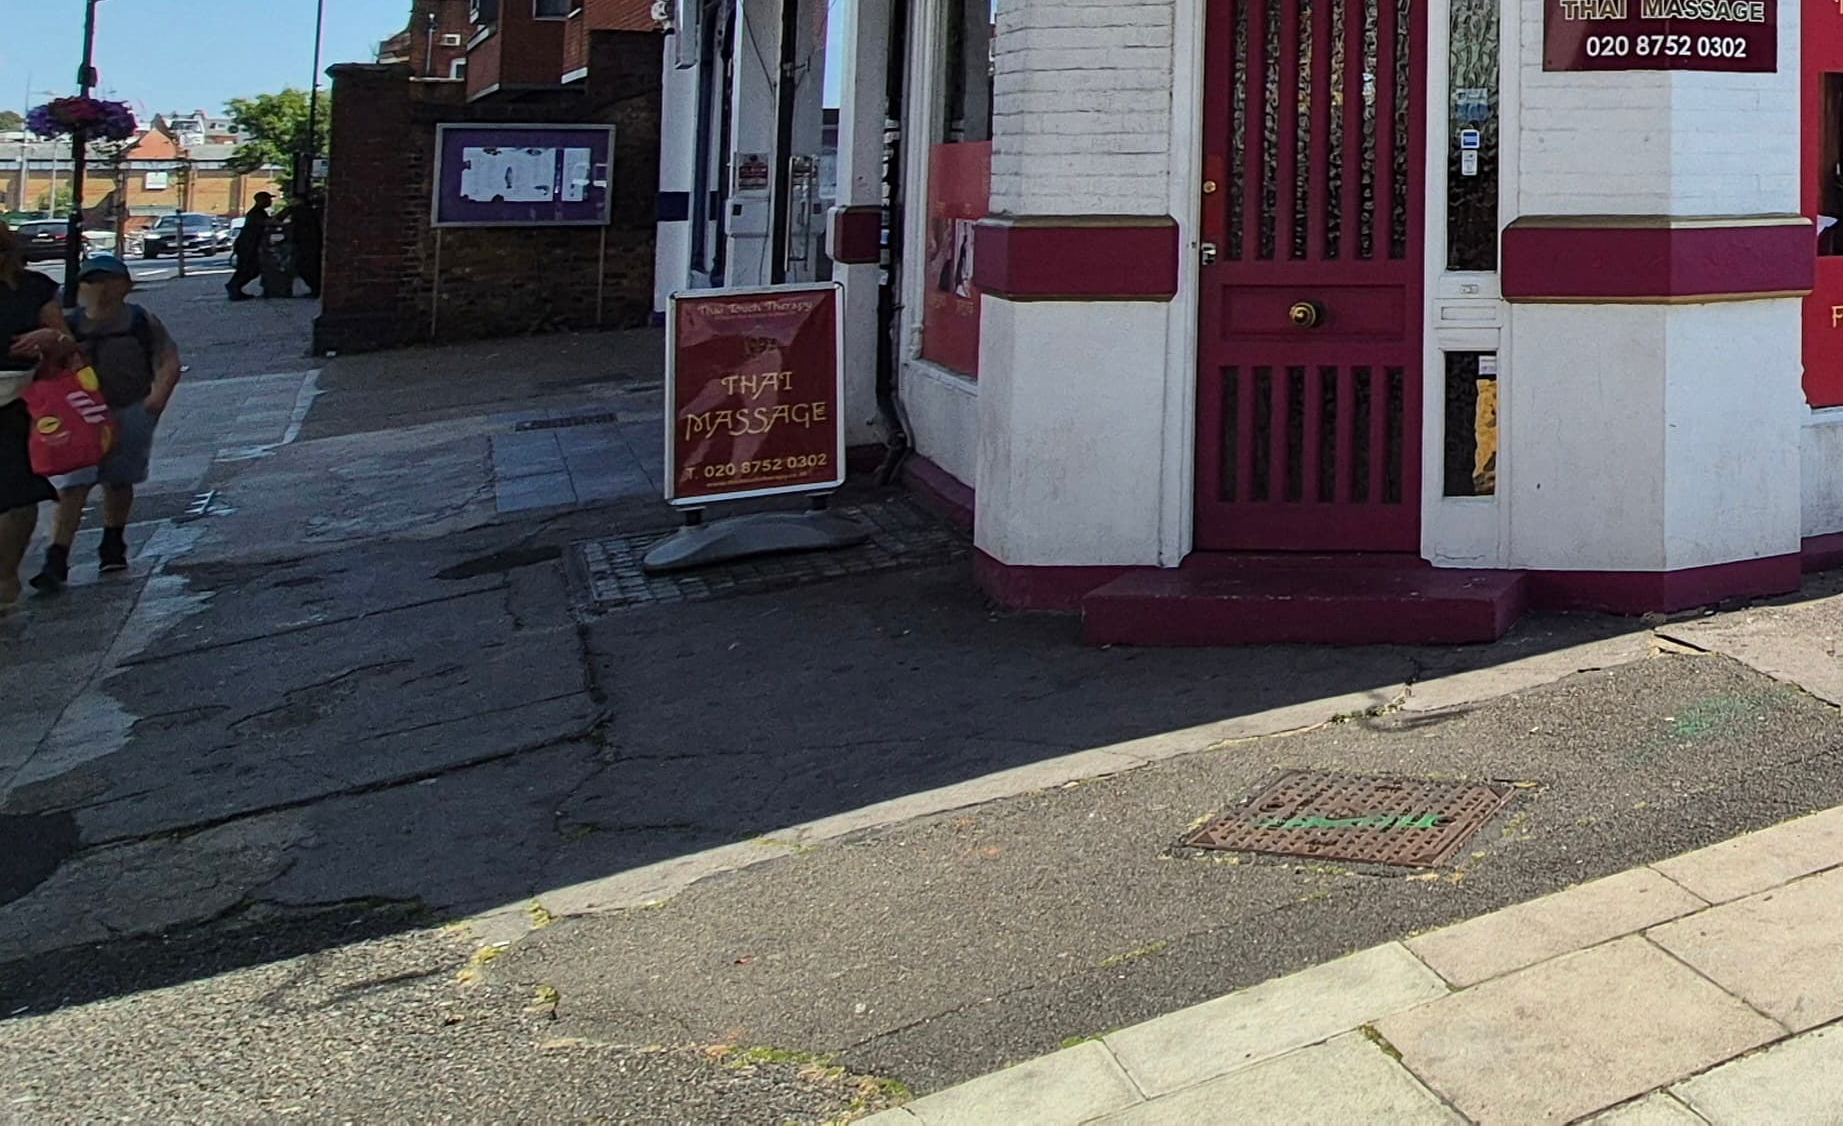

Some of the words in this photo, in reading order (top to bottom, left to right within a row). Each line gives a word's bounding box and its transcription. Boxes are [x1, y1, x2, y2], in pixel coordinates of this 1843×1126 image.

[1586, 36, 1630, 57] 020
[1636, 35, 1691, 56] 8752
[1697, 36, 1747, 58] 0302
[697, 303, 723, 315] Thai
[727, 302, 761, 314] Touch
[763, 300, 814, 314] Therapy
[721, 371, 792, 400] THAI
[685, 401, 827, 441] MASSAGE
[704, 463, 736, 479] 020
[740, 457, 782, 475] 8752
[787, 452, 828, 470] 0302
